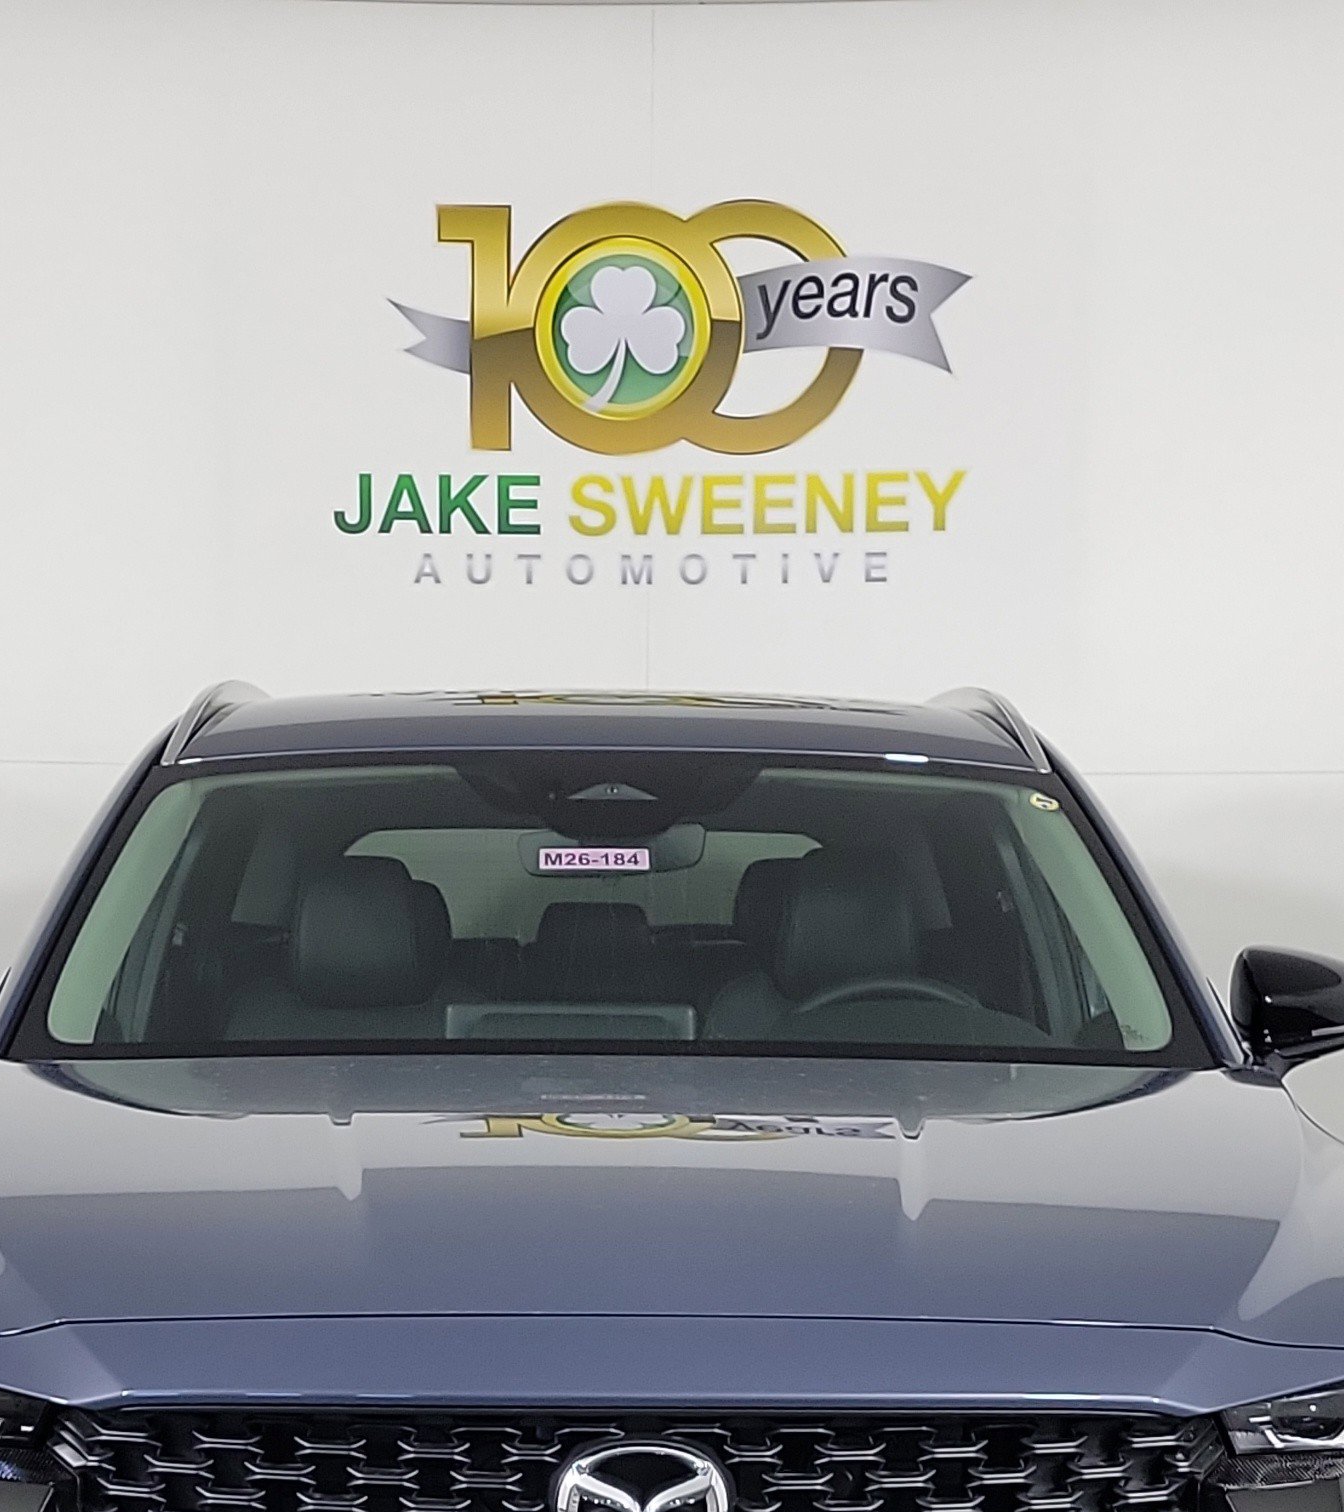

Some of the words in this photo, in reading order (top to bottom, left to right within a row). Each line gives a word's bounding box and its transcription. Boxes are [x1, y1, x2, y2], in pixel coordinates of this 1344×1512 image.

[436, 198, 865, 455] 100
[756, 271, 918, 339] years
[333, 473, 541, 536] JAKE
[568, 470, 967, 535] SWEENEY
[414, 551, 888, 585] AUTOMOTIVE
[544, 853, 640, 866] M26-184
